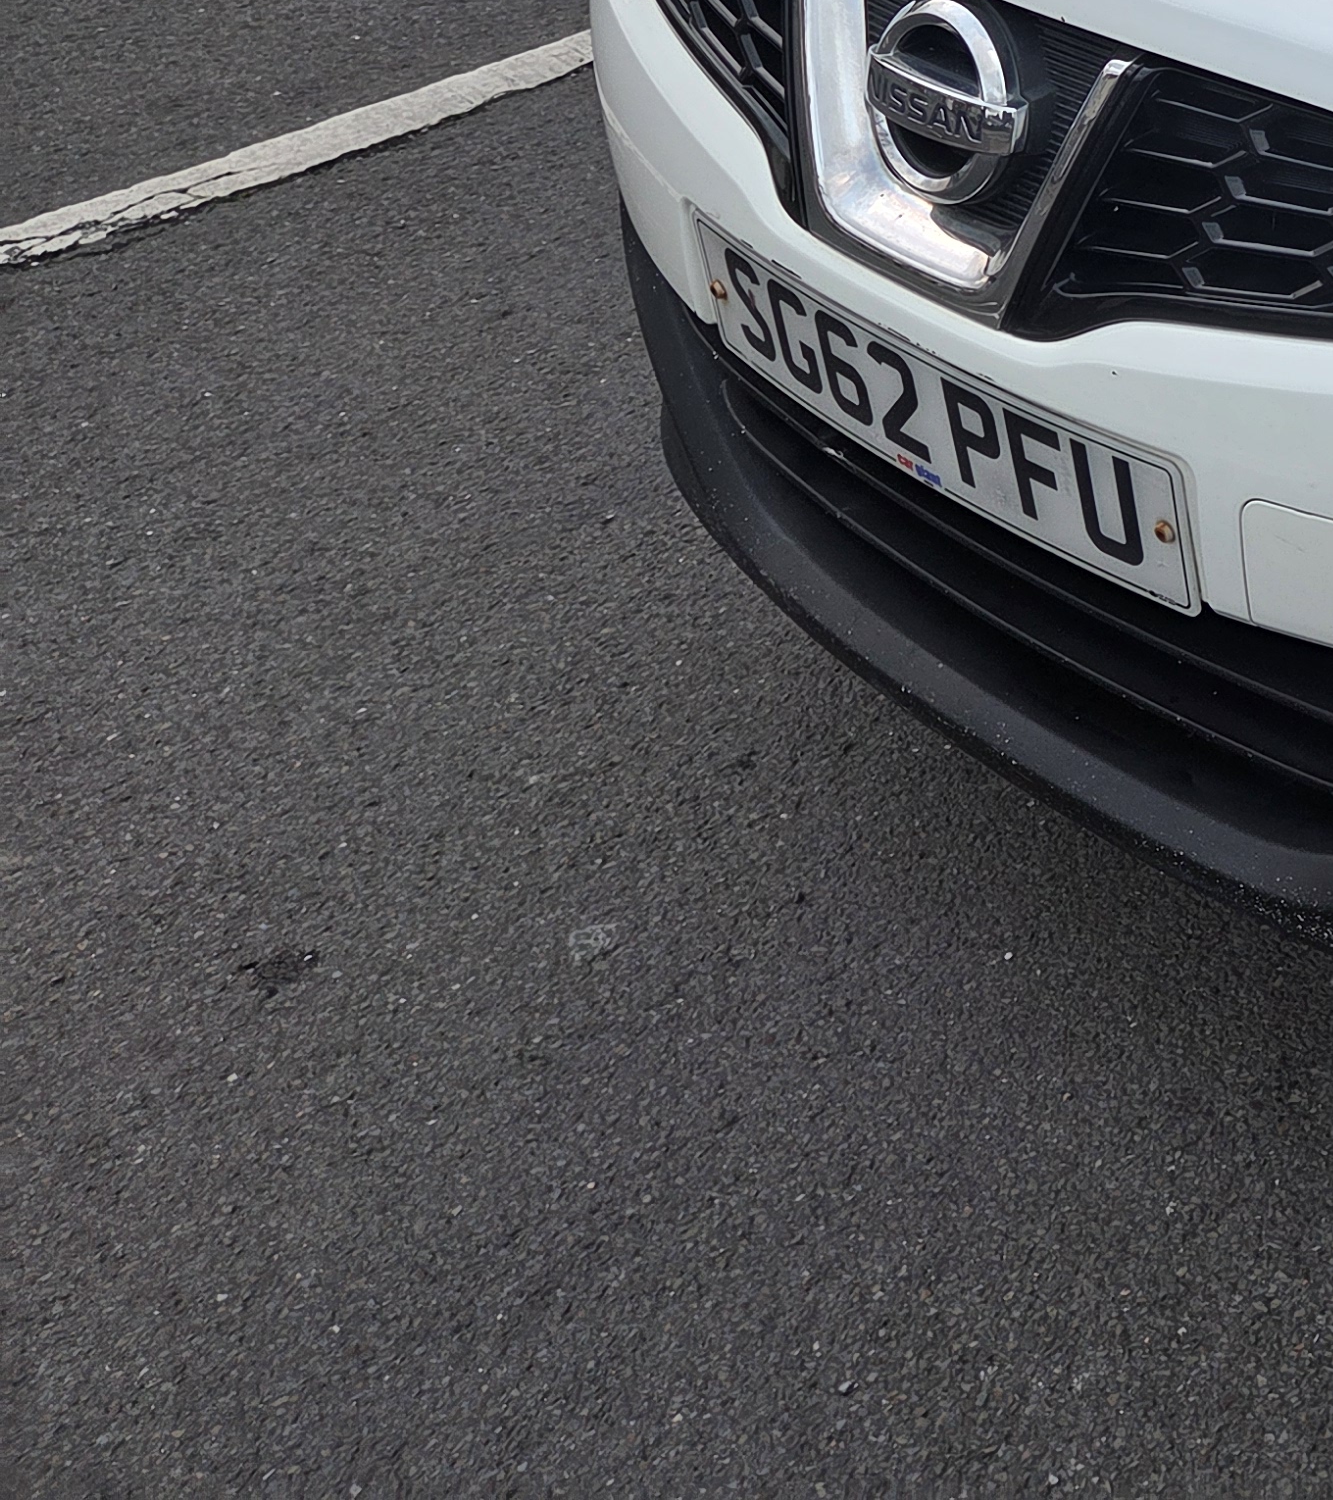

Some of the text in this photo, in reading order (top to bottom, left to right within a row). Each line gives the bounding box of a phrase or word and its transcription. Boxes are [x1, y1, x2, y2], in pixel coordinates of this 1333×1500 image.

[869, 62, 984, 144] NISSAN
[724, 247, 1144, 567] SG62 PFU
